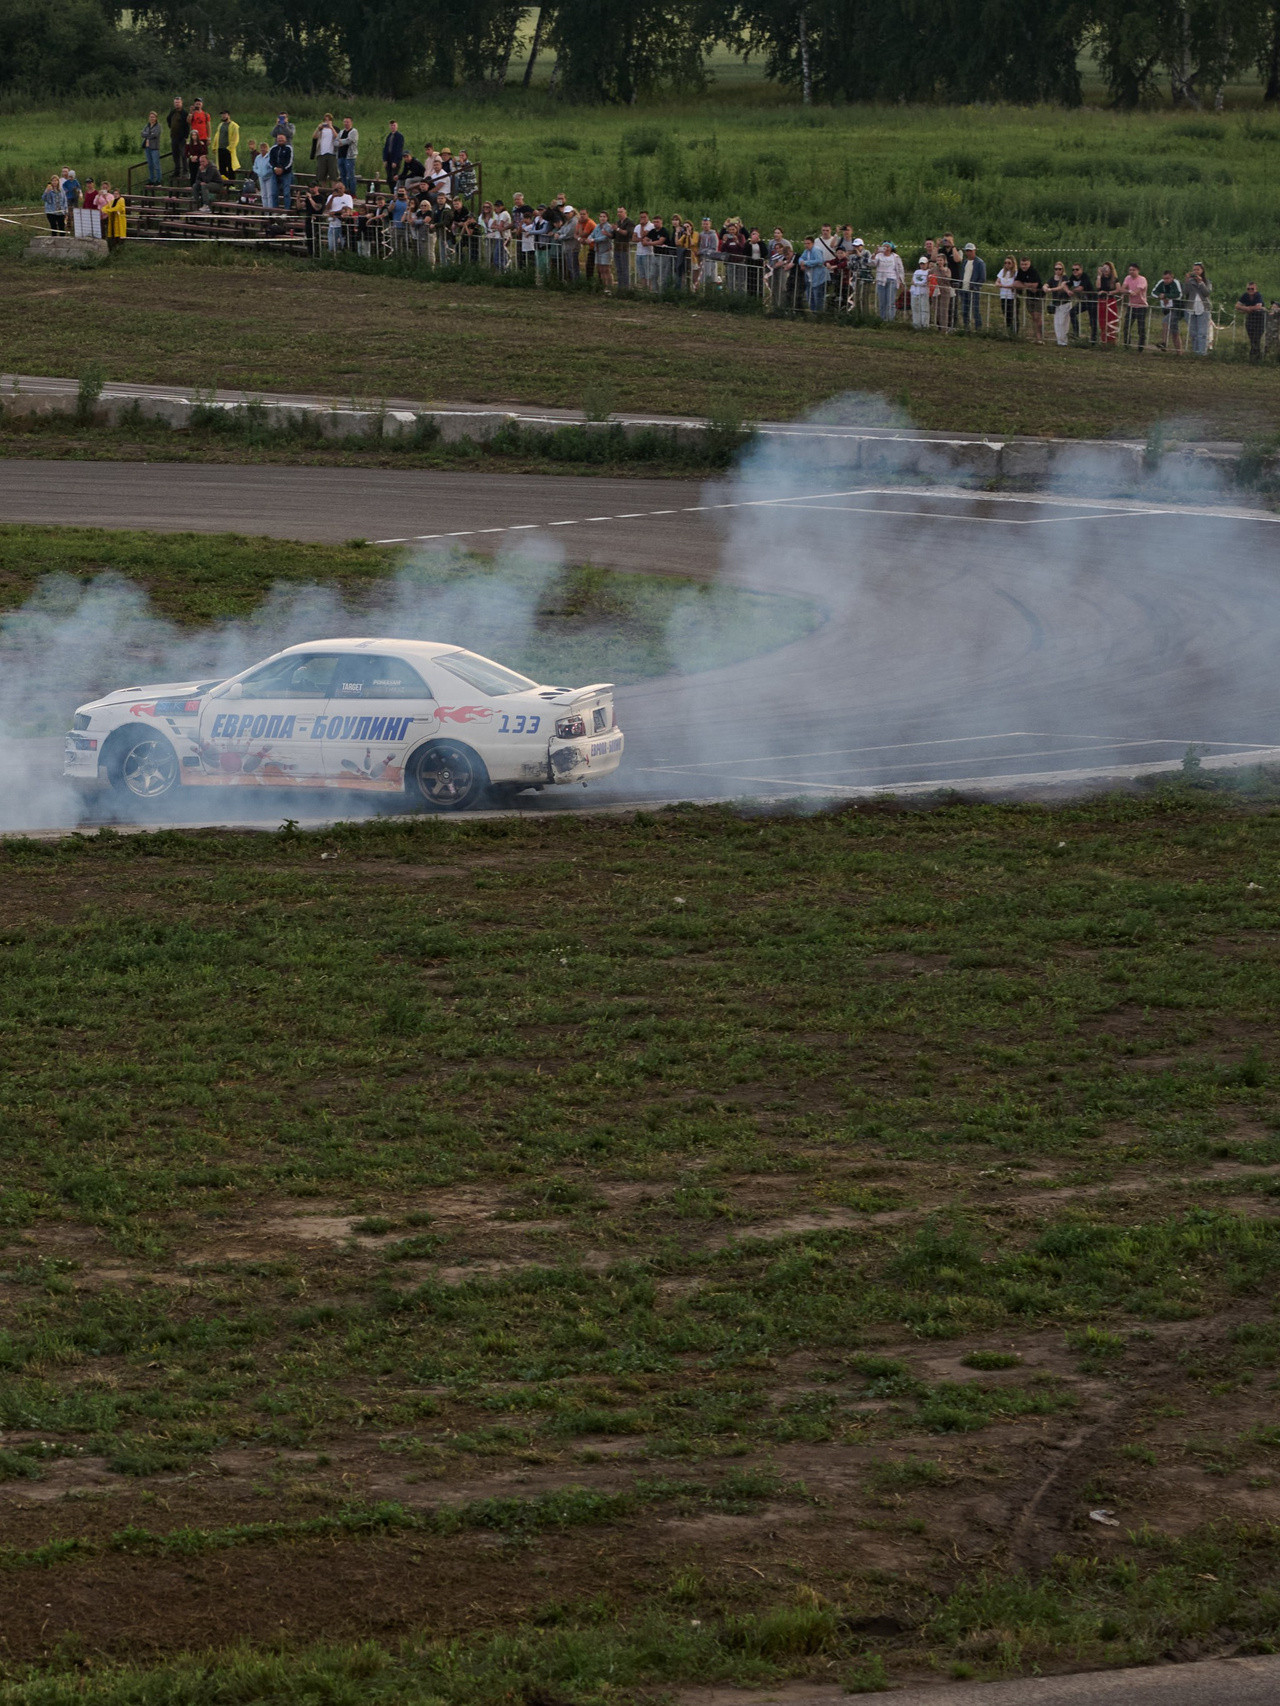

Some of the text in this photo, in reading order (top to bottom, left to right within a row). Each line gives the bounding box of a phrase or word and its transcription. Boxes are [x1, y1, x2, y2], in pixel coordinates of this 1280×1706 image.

[341, 682, 363, 691] TARGET
[211, 713, 296, 739] ЕВРОПА
[310, 715, 415, 741] БОУЛИНГ
[498, 714, 541, 735] 133
